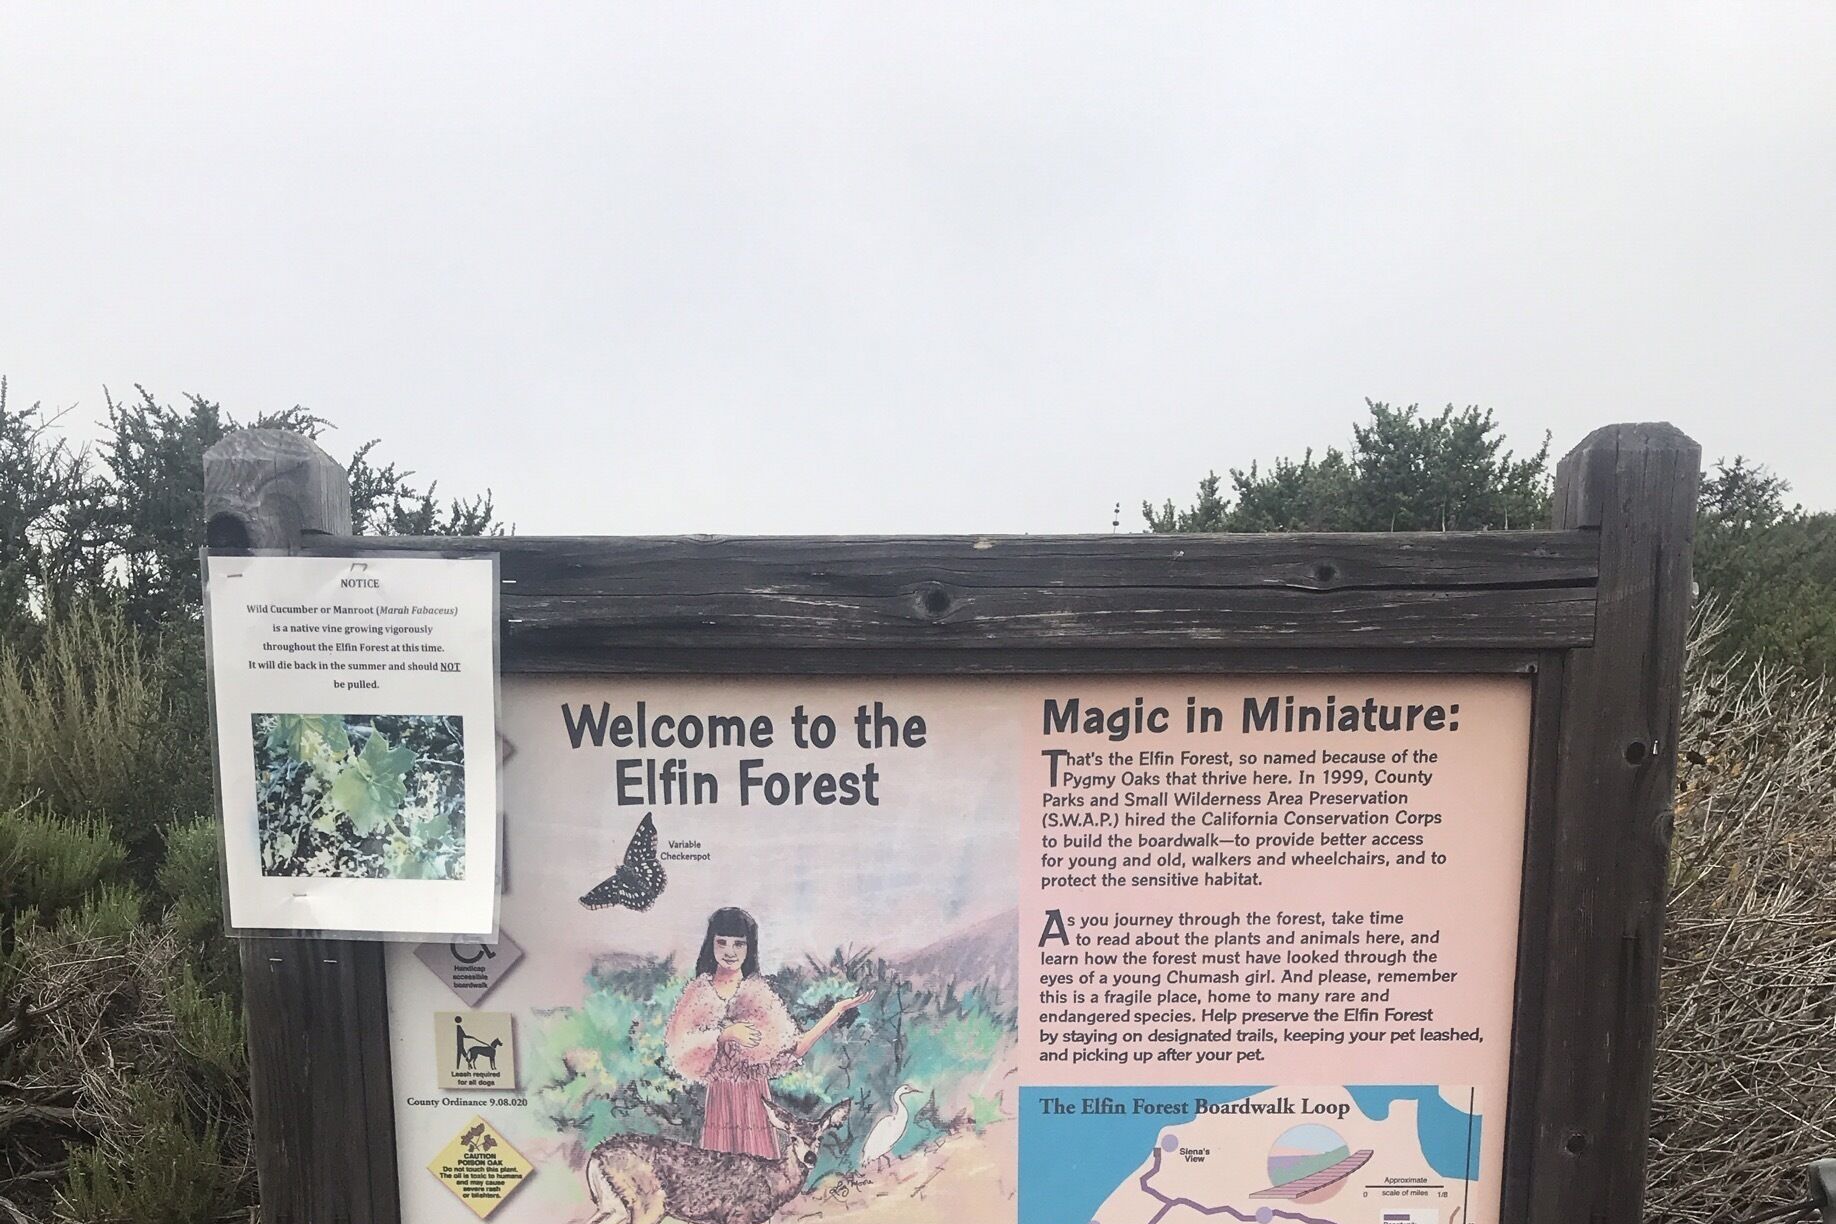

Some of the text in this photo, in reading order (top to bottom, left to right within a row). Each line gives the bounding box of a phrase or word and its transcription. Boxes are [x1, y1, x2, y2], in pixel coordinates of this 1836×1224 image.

[340, 579, 380, 589] NOTICE
[246, 604, 268, 614] Wild
[270, 604, 319, 614] Cucumber
[333, 605, 374, 615] Manroot
[376, 606, 409, 616] (Marah
[411, 606, 458, 617] Fabaceus)
[273, 624, 281, 632] is
[290, 624, 320, 633] native
[322, 624, 343, 633] vine
[344, 624, 384, 636] growing
[385, 625, 433, 636] vigorously
[263, 642, 445, 653] throughout the Elfin Forest at this time.
[248, 660, 256, 669] It
[257, 660, 275, 669] will
[277, 660, 292, 670] die
[294, 661, 317, 670] back
[319, 661, 328, 670] in
[330, 661, 346, 670] the
[388, 662, 406, 671] and
[407, 662, 438, 671] should
[440, 662, 461, 673] NOT
[333, 680, 380, 691] be pulled.
[561, 700, 927, 749] Welcome to the
[1043, 695, 1459, 742] Magic in Miniature:
[1042, 749, 1438, 787] That's the Elfin Forest, so named because of the
[616, 758, 879, 806] Elfin Forest
[1063, 769, 1433, 789] Pygmy Oaks that thrive here. In 1999, County
[1043, 790, 1408, 808] Parks and Small Wilderness Area Preservation
[1042, 810, 1442, 829] (S.W.A.P.) hired the California Conservation Corps
[668, 840, 701, 849] Variable
[660, 851, 711, 862] Checkerspot
[1080, 916, 1109, 929] you
[1113, 912, 1174, 929] journey
[1178, 911, 1240, 928] through
[1246, 911, 1271, 925] the
[1276, 911, 1325, 927] forest,
[1331, 910, 1364, 925] take
[1369, 910, 1404, 925] time
[407, 1098, 528, 1107] County Ordinance 9.08.020
[1039, 1098, 1350, 1119] The Elfin Forest Boardwalk Loop
[1179, 1147, 1210, 1155] Siena's
